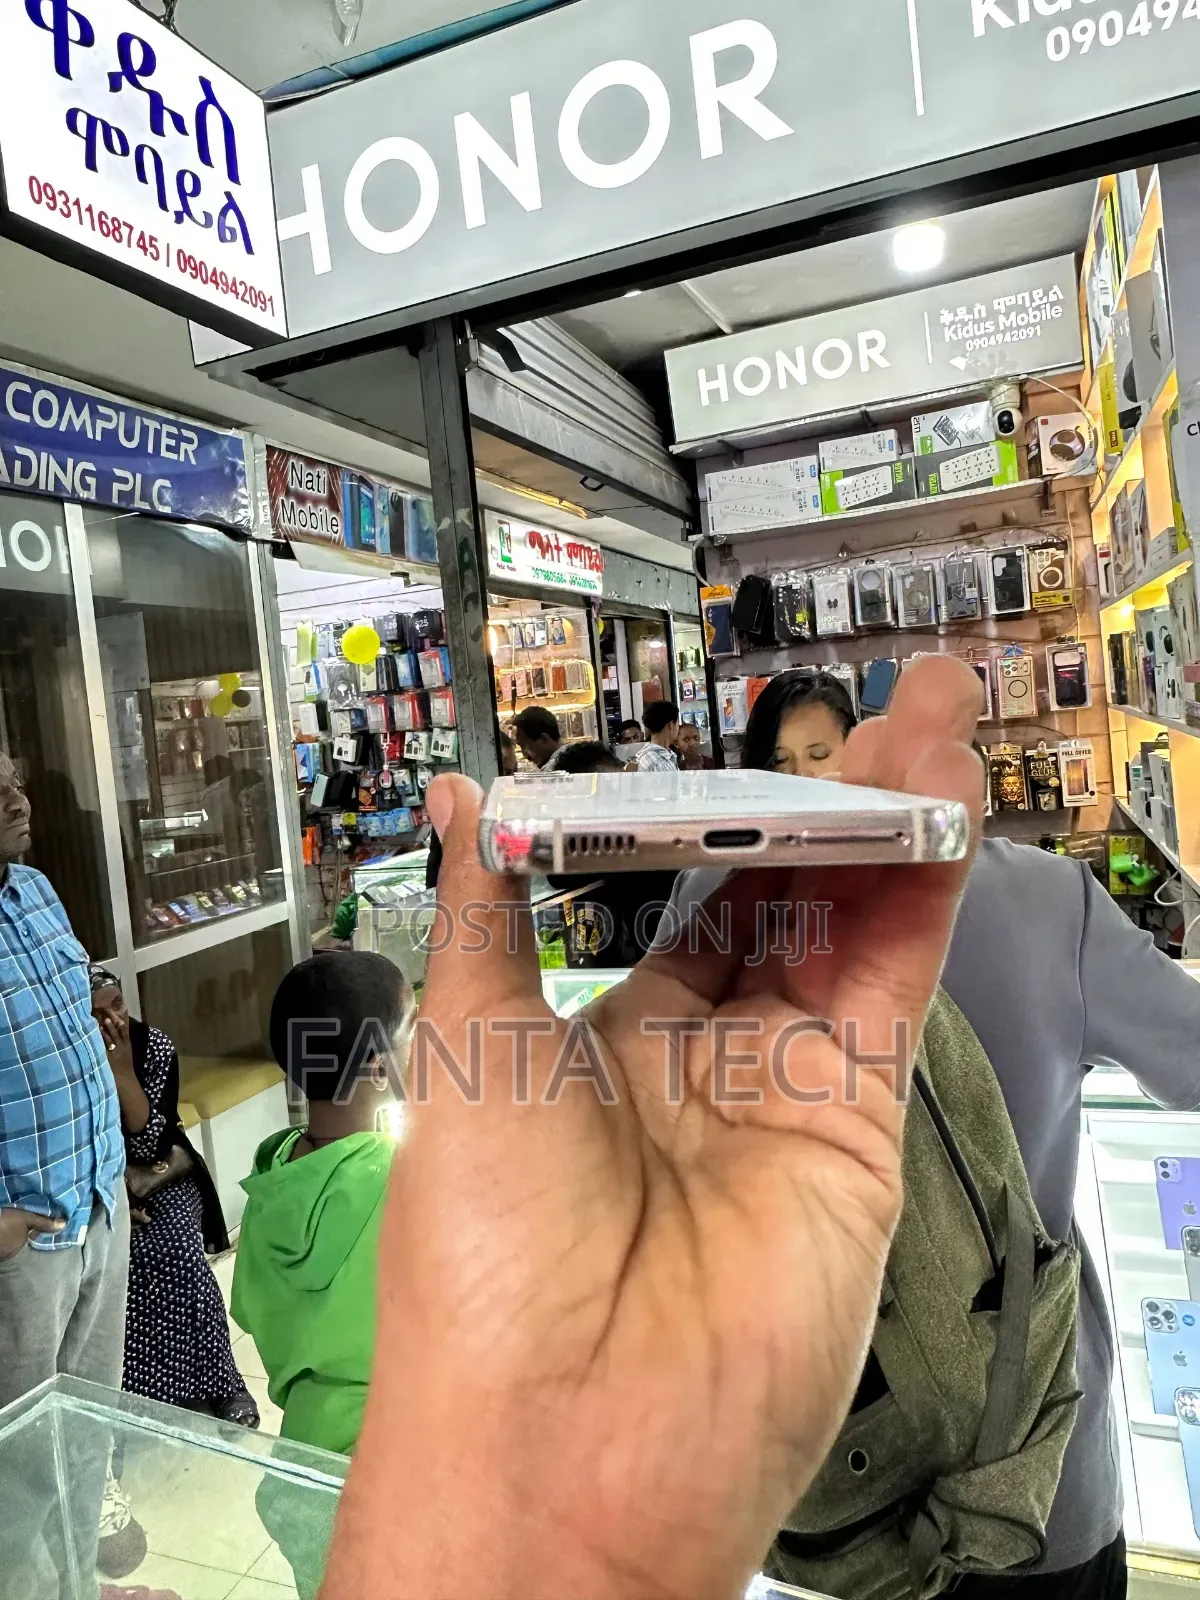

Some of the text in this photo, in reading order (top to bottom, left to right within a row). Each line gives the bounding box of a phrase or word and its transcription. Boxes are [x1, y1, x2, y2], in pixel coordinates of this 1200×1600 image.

[277, 18, 795, 276] HONOR
[28, 175, 160, 261] 0931168745
[176, 248, 275, 317] 0904942091
[943, 302, 1063, 343] Kidus Mobile
[965, 324, 1041, 352] 0904942091
[696, 328, 892, 407] HONOR
[5, 380, 199, 465] COMPUTER
[112, 467, 173, 514] PLC
[290, 461, 326, 495] Nati
[281, 498, 339, 535] Mobile
[1030, 759, 1056, 770] FULL
[1031, 768, 1057, 777] GLUE
